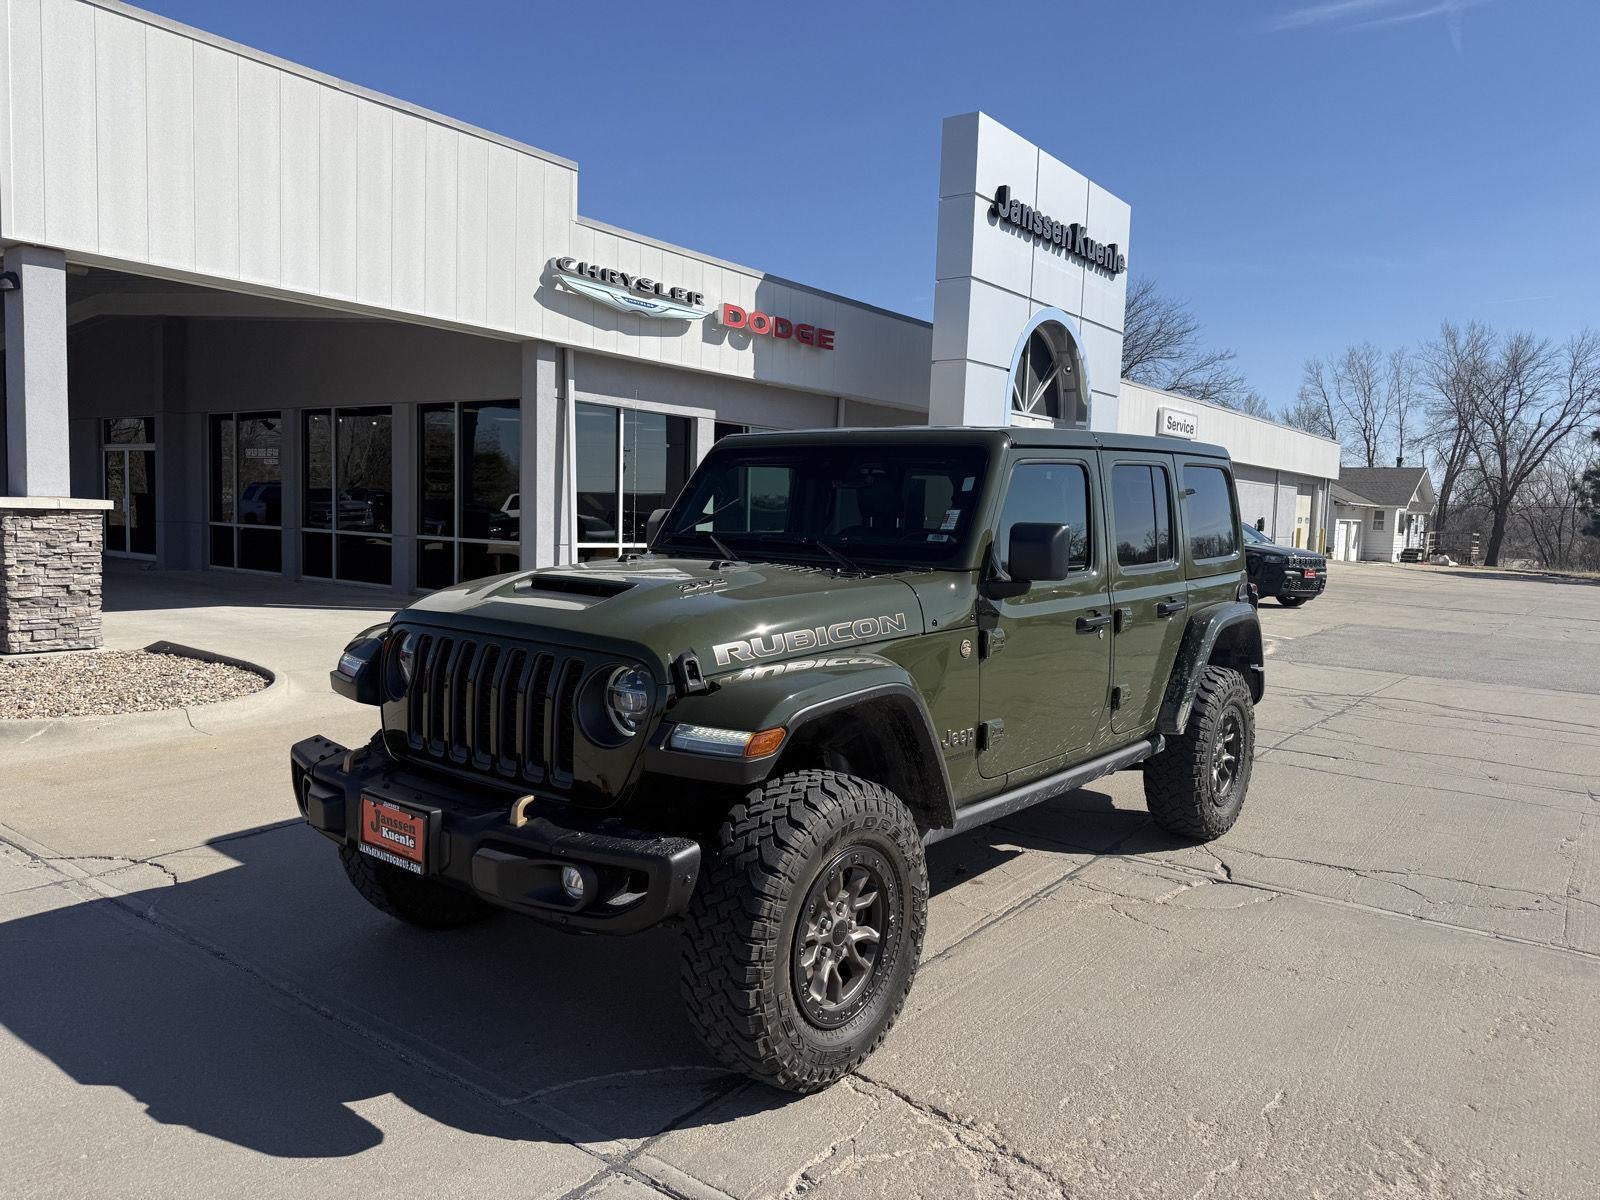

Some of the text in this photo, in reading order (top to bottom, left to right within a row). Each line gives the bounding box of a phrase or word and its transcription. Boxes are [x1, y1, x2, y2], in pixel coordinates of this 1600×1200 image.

[994, 185, 1126, 274] Janssen Kuenle
[555, 256, 705, 305] CHRYSLER
[719, 302, 836, 350] DODGE
[1167, 415, 1195, 434] Service
[712, 613, 906, 666] RUBICON
[941, 728, 976, 750] Jeep
[370, 808, 416, 836] Janssen
[381, 826, 415, 848] Kuenle
